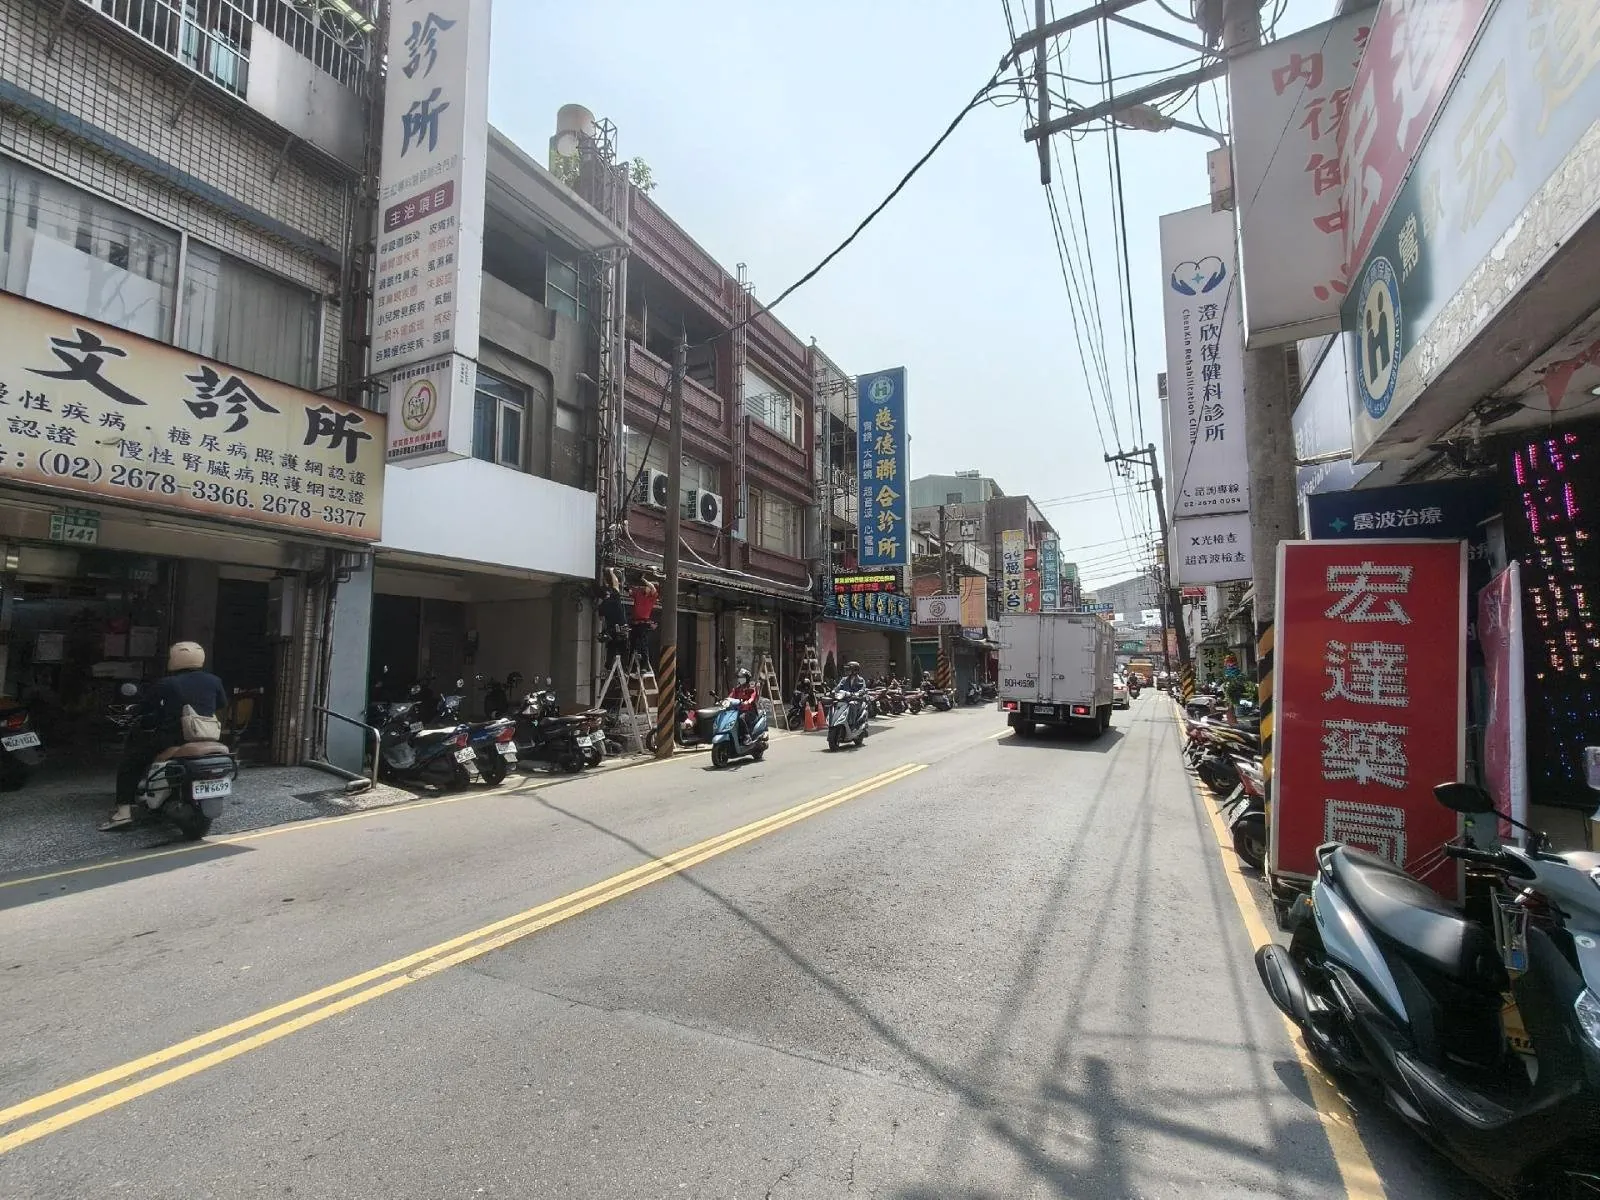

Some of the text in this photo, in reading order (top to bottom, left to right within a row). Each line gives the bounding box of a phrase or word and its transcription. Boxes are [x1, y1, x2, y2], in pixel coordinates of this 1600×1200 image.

[389, 189, 446, 226] 主治項目
[1198, 303, 1225, 442] 澄欣復健科診所
[1353, 506, 1443, 531] 震波治療
[1191, 532, 1238, 546] X光檢查
[1184, 551, 1247, 566] 超音波檢查
[1321, 560, 1413, 872] 宏達藥局
